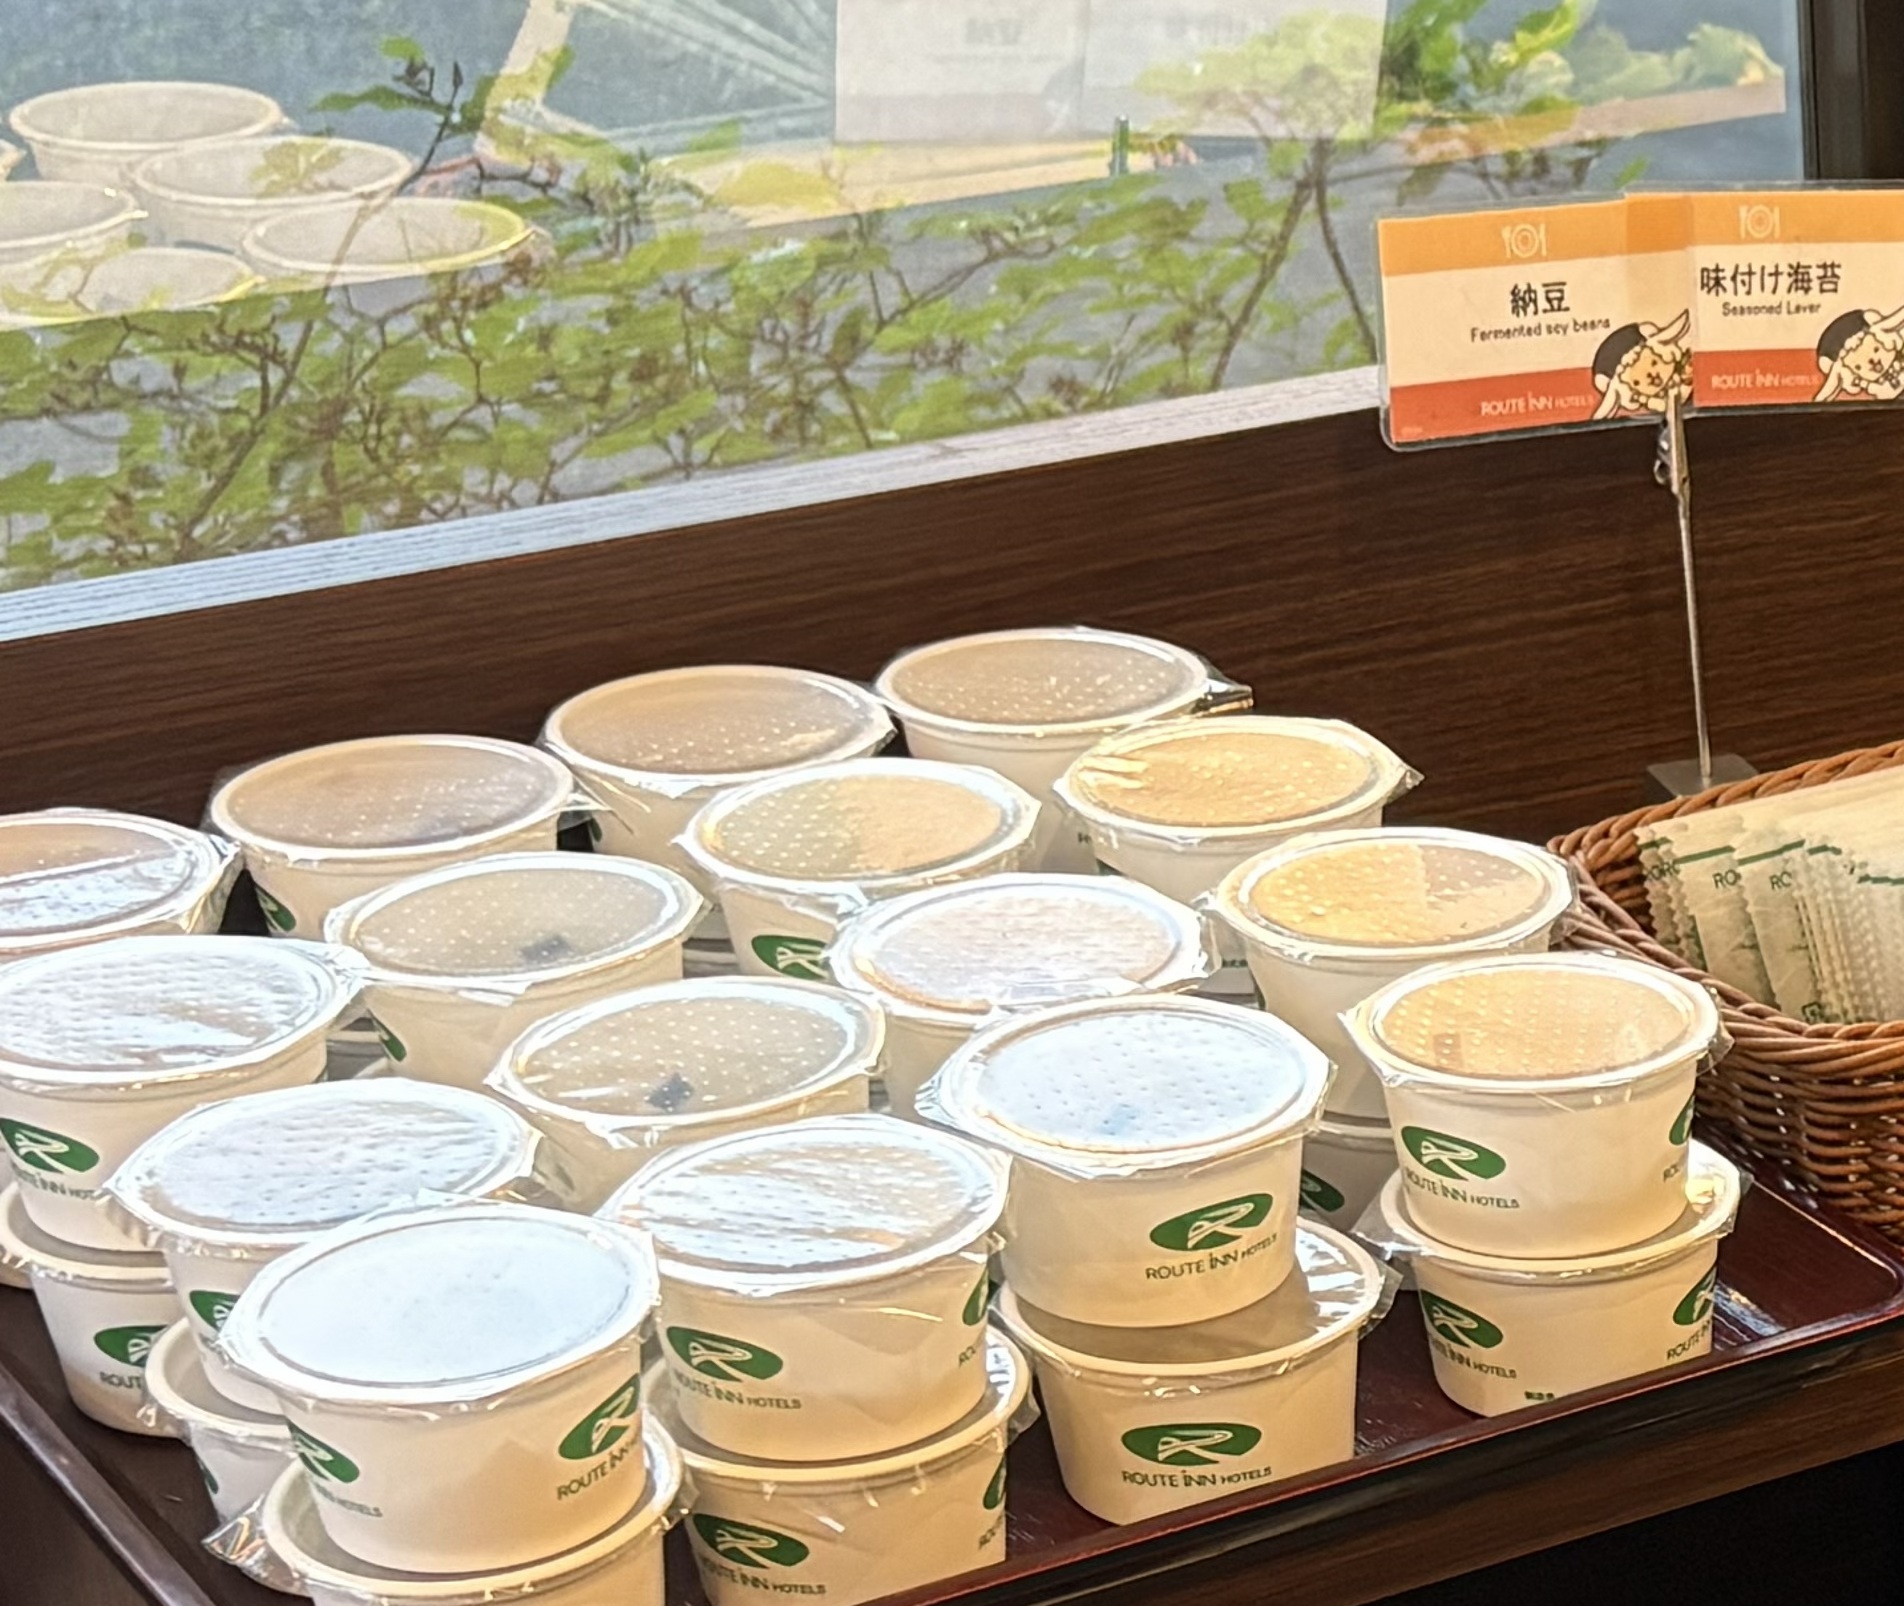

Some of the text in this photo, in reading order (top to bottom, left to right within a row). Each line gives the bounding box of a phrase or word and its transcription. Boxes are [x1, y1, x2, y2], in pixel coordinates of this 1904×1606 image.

[1700, 261, 1842, 297] 味付け海苔
[1510, 282, 1570, 317] 納豆
[1722, 301, 1782, 317] Seasoned
[1471, 323, 1542, 342] Fermented
[1481, 397, 1526, 416] ROUTE
[1471, 1195, 1520, 1209] HOTELS
[1145, 1233, 1278, 1281] ROUTE INN HOTELS
[1473, 1361, 1517, 1379] HOTELS
[747, 1397, 802, 1409] HOTELS
[557, 1461, 608, 1501] ROUTE
[1122, 1465, 1272, 1488] ROUTE INN HOTELS
[772, 1584, 826, 1595] HOTELS
